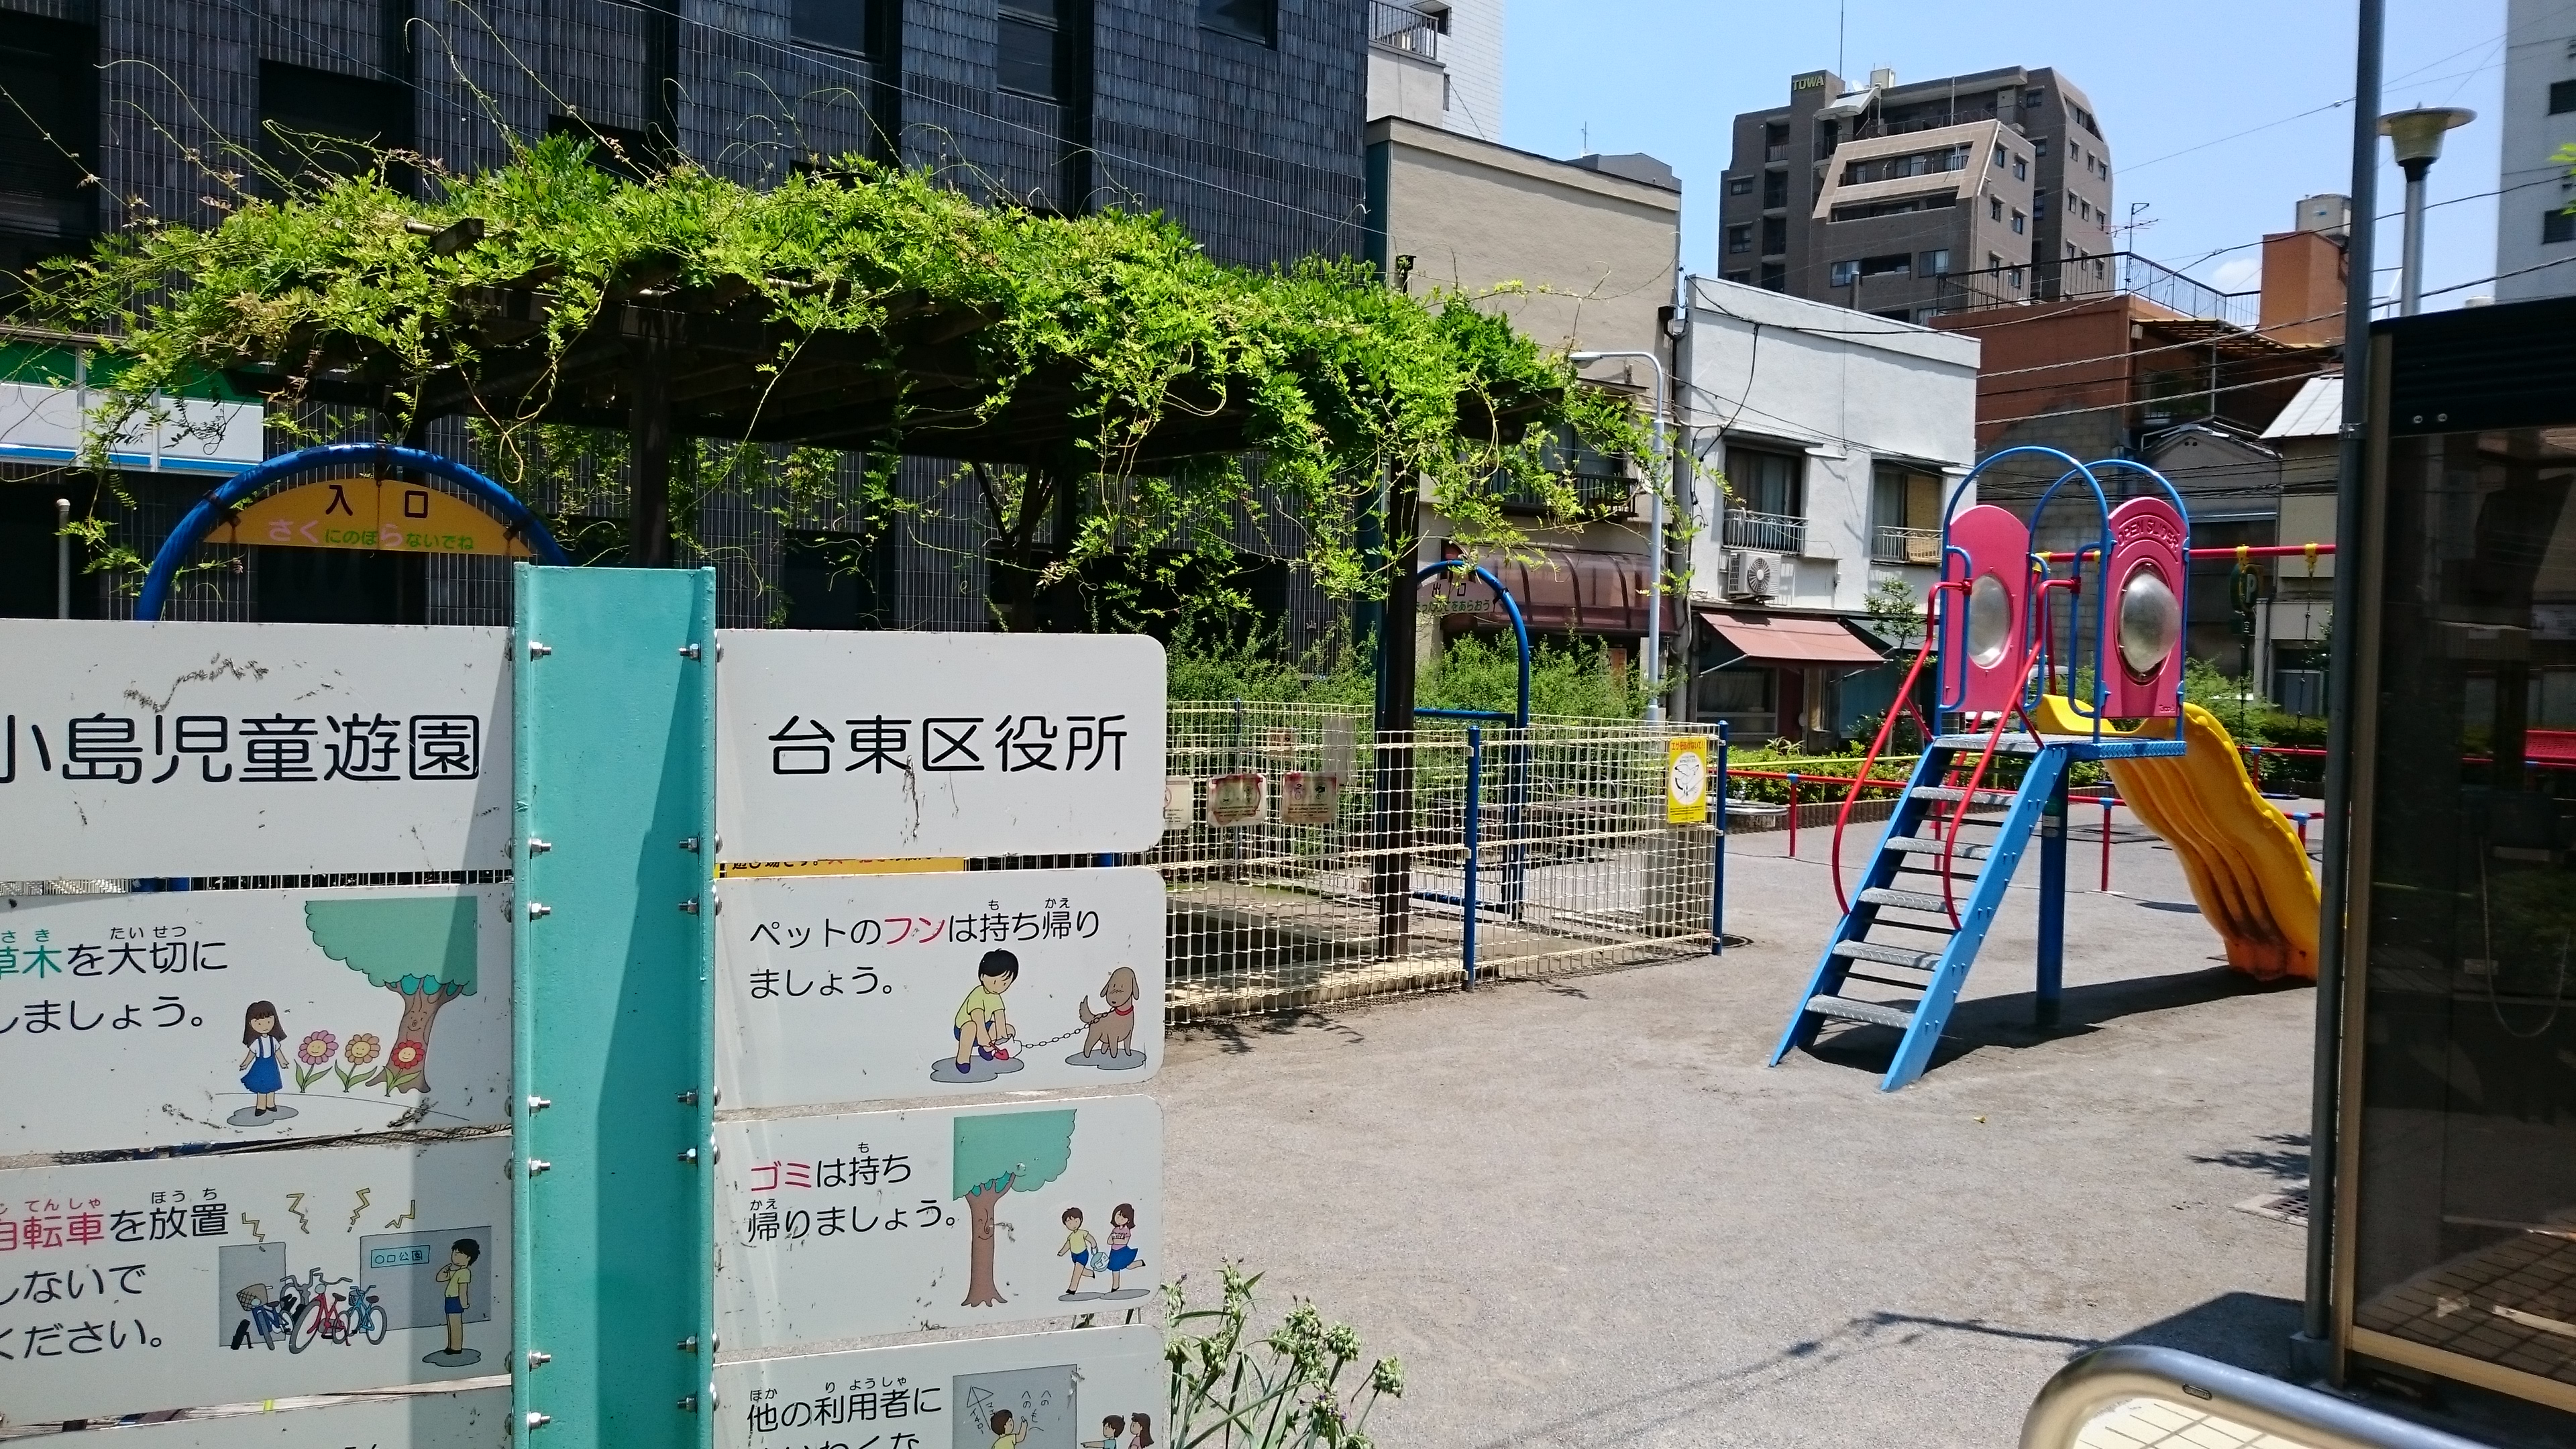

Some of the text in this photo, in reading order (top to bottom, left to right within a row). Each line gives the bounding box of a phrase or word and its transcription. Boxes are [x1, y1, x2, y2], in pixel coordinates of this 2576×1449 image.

[1793, 75, 1825, 91] TOWA
[325, 484, 429, 518] 入口
[2118, 519, 2179, 553] OPEN SLIDER
[0, 712, 479, 784] 小島児童遊園
[768, 715, 1128, 775] 台東区役所
[987, 898, 1071, 911] も かえ
[110, 926, 187, 940] たいせつ
[749, 910, 1099, 949] ペットのフンは持ち帰り
[749, 966, 892, 999] ましょう。
[858, 1142, 869, 1153] も
[751, 1154, 912, 1191] ゴミは持ち
[748, 1199, 955, 1242] 帰りましょう。
[749, 1198, 777, 1211] かえ
[747, 1387, 942, 1432] 他の利用者に
[749, 1388, 777, 1401] ほか
